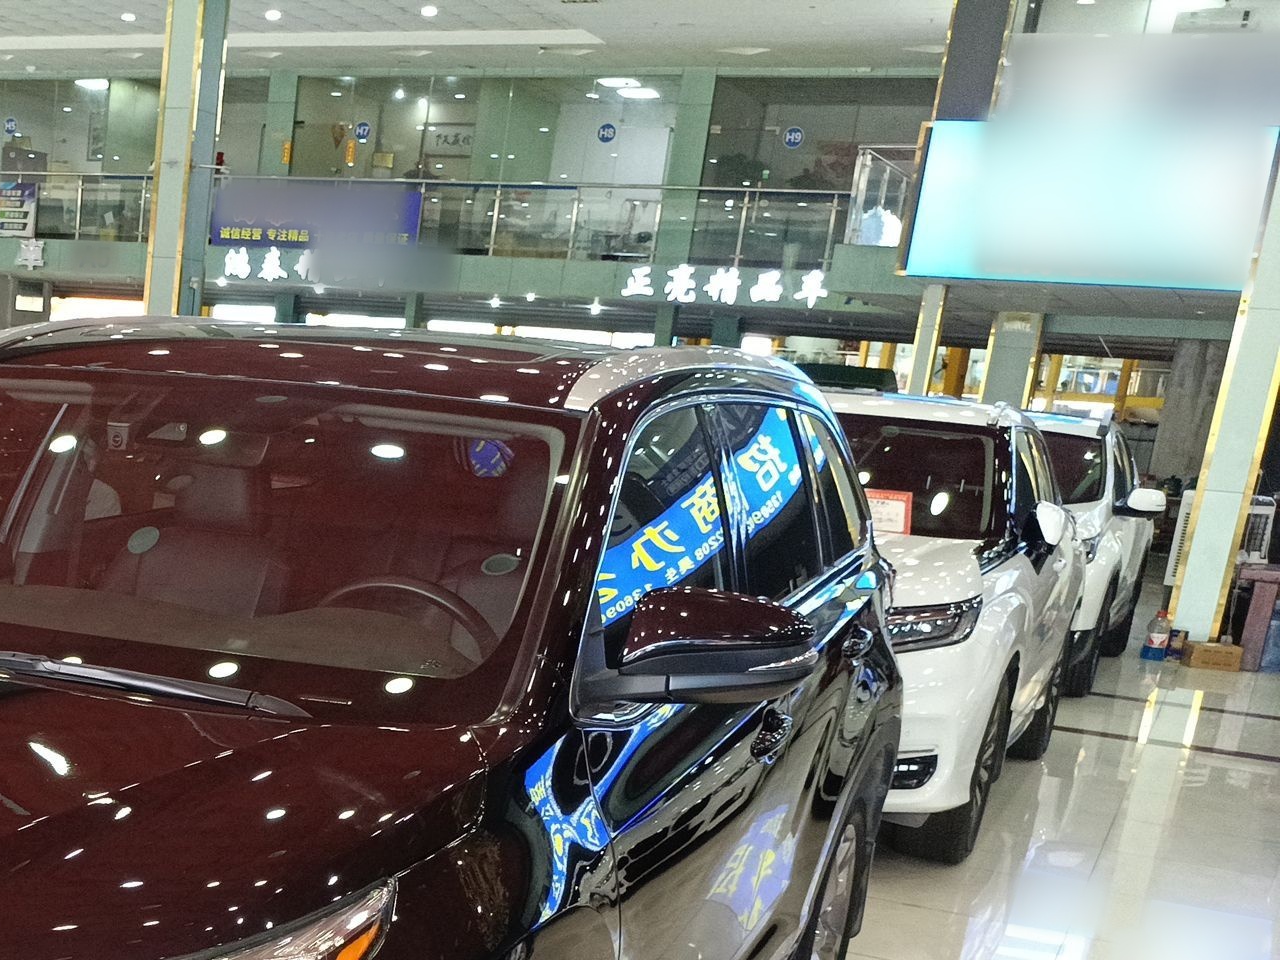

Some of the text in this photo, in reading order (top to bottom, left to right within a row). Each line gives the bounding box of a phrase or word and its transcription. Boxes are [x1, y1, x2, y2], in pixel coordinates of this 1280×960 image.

[355, 126, 370, 136] H7
[599, 127, 615, 139] H8
[785, 131, 802, 143] H9
